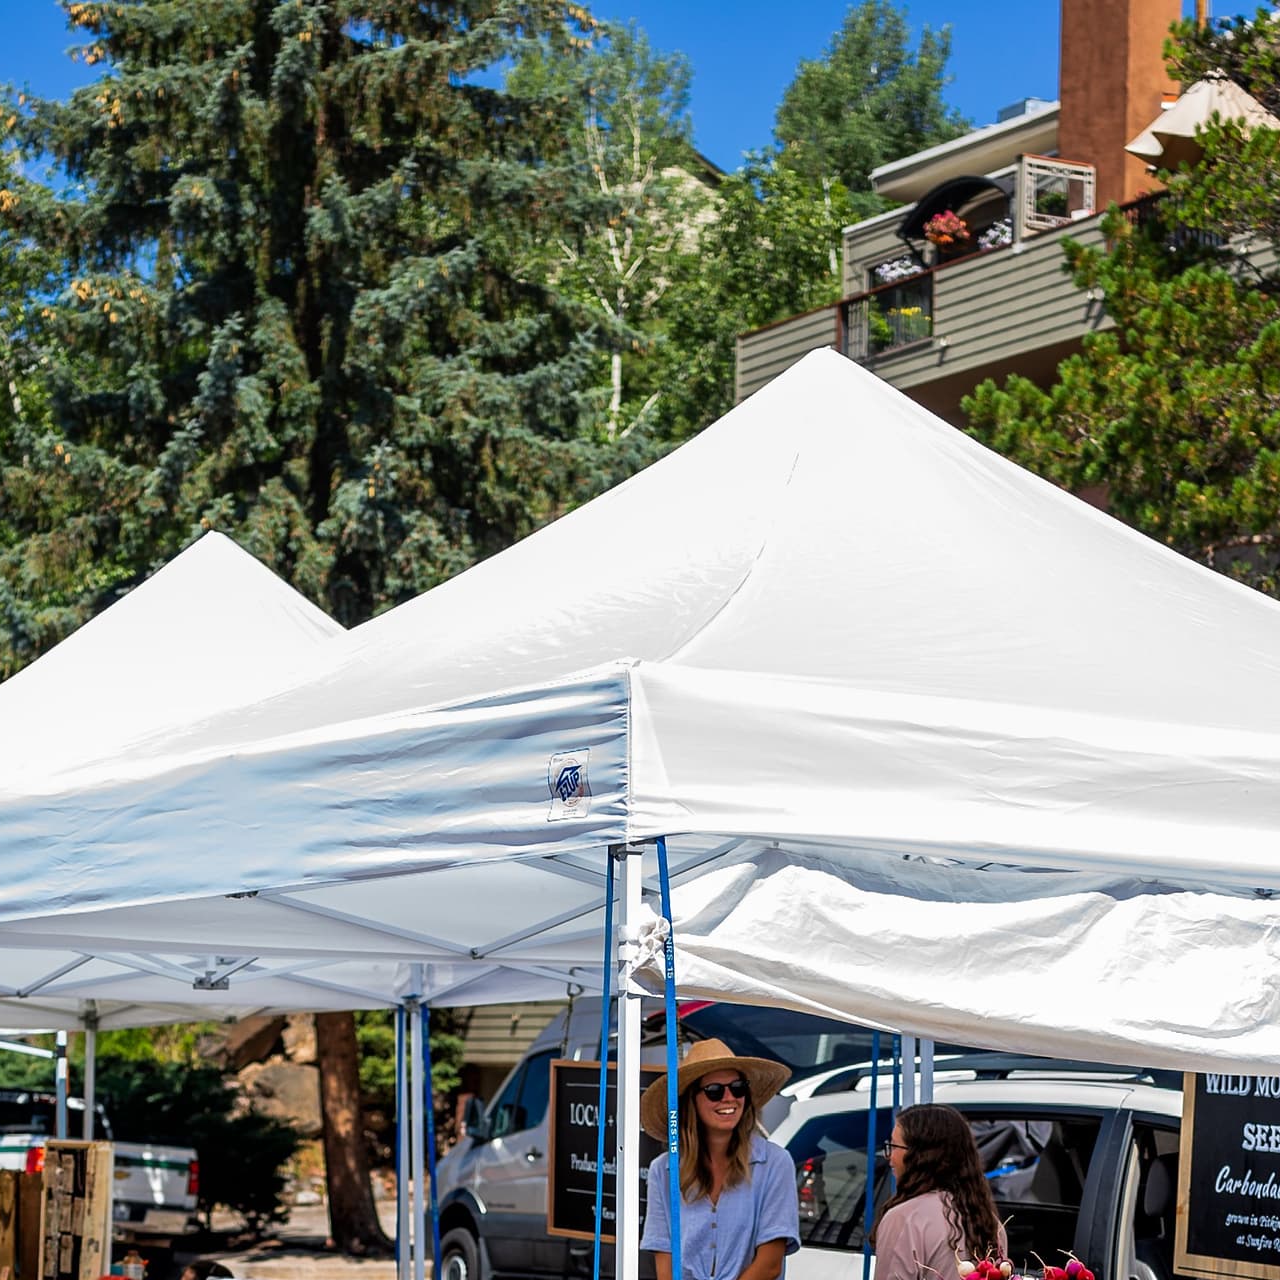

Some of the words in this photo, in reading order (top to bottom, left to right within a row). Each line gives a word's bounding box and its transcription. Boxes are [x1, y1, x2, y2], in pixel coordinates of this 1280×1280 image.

[1206, 1073, 1251, 1096] WILD
[570, 1103, 607, 1127] LOCA
[1225, 1213, 1250, 1227] grown
[1250, 1214, 1258, 1227] in
[1236, 1235, 1245, 1245] at
[1245, 1234, 1273, 1251] Sunfire
